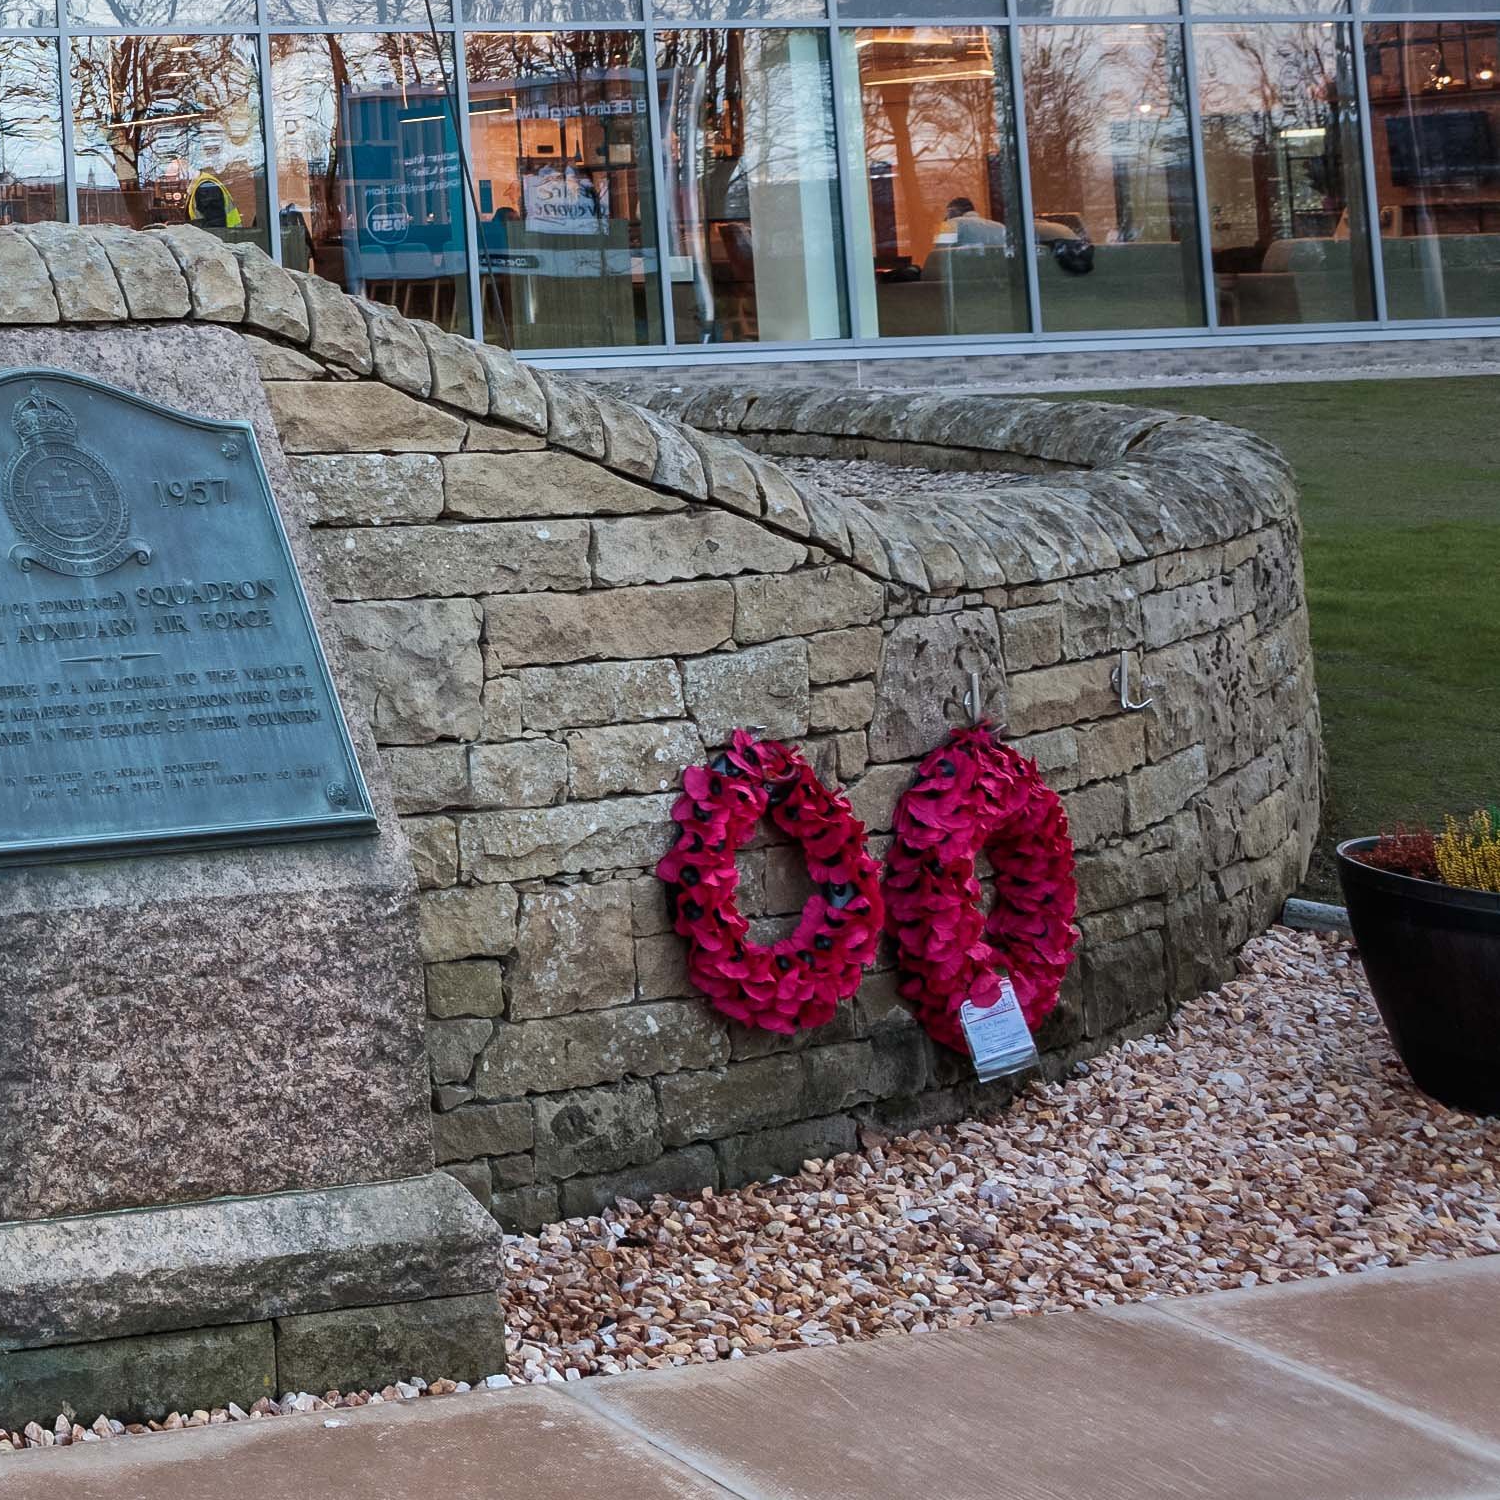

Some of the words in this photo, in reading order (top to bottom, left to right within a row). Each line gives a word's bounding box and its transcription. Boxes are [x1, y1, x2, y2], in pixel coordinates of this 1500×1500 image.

[152, 477, 229, 508] 1957
[11, 602, 29, 618] OF
[39, 590, 129, 615] EDINBURGH)
[135, 578, 280, 609] SQUADRON
[15, 618, 137, 645] AUXILIARY
[152, 614, 191, 635] AIR
[199, 608, 273, 631] FORCE
[49, 682, 64, 697] IS
[69, 682, 81, 695] A
[86, 673, 171, 693] MEMORIAL
[175, 672, 199, 688] TO
[205, 668, 239, 684] THE
[244, 664, 307, 682] VALOUR
[9, 703, 81, 722] MEMBERS
[87, 701, 106, 716] OF
[110, 698, 144, 715] THE
[147, 693, 232, 711] SQUADRON
[234, 689, 272, 705] WHO
[278, 686, 317, 702] GAVE
[38, 729, 56, 742] IN
[59, 726, 96, 741] THE
[100, 720, 162, 739] SERVICE
[166, 717, 187, 733] OF
[190, 714, 241, 731] THEIR
[247, 709, 323, 727] COUNTRY
